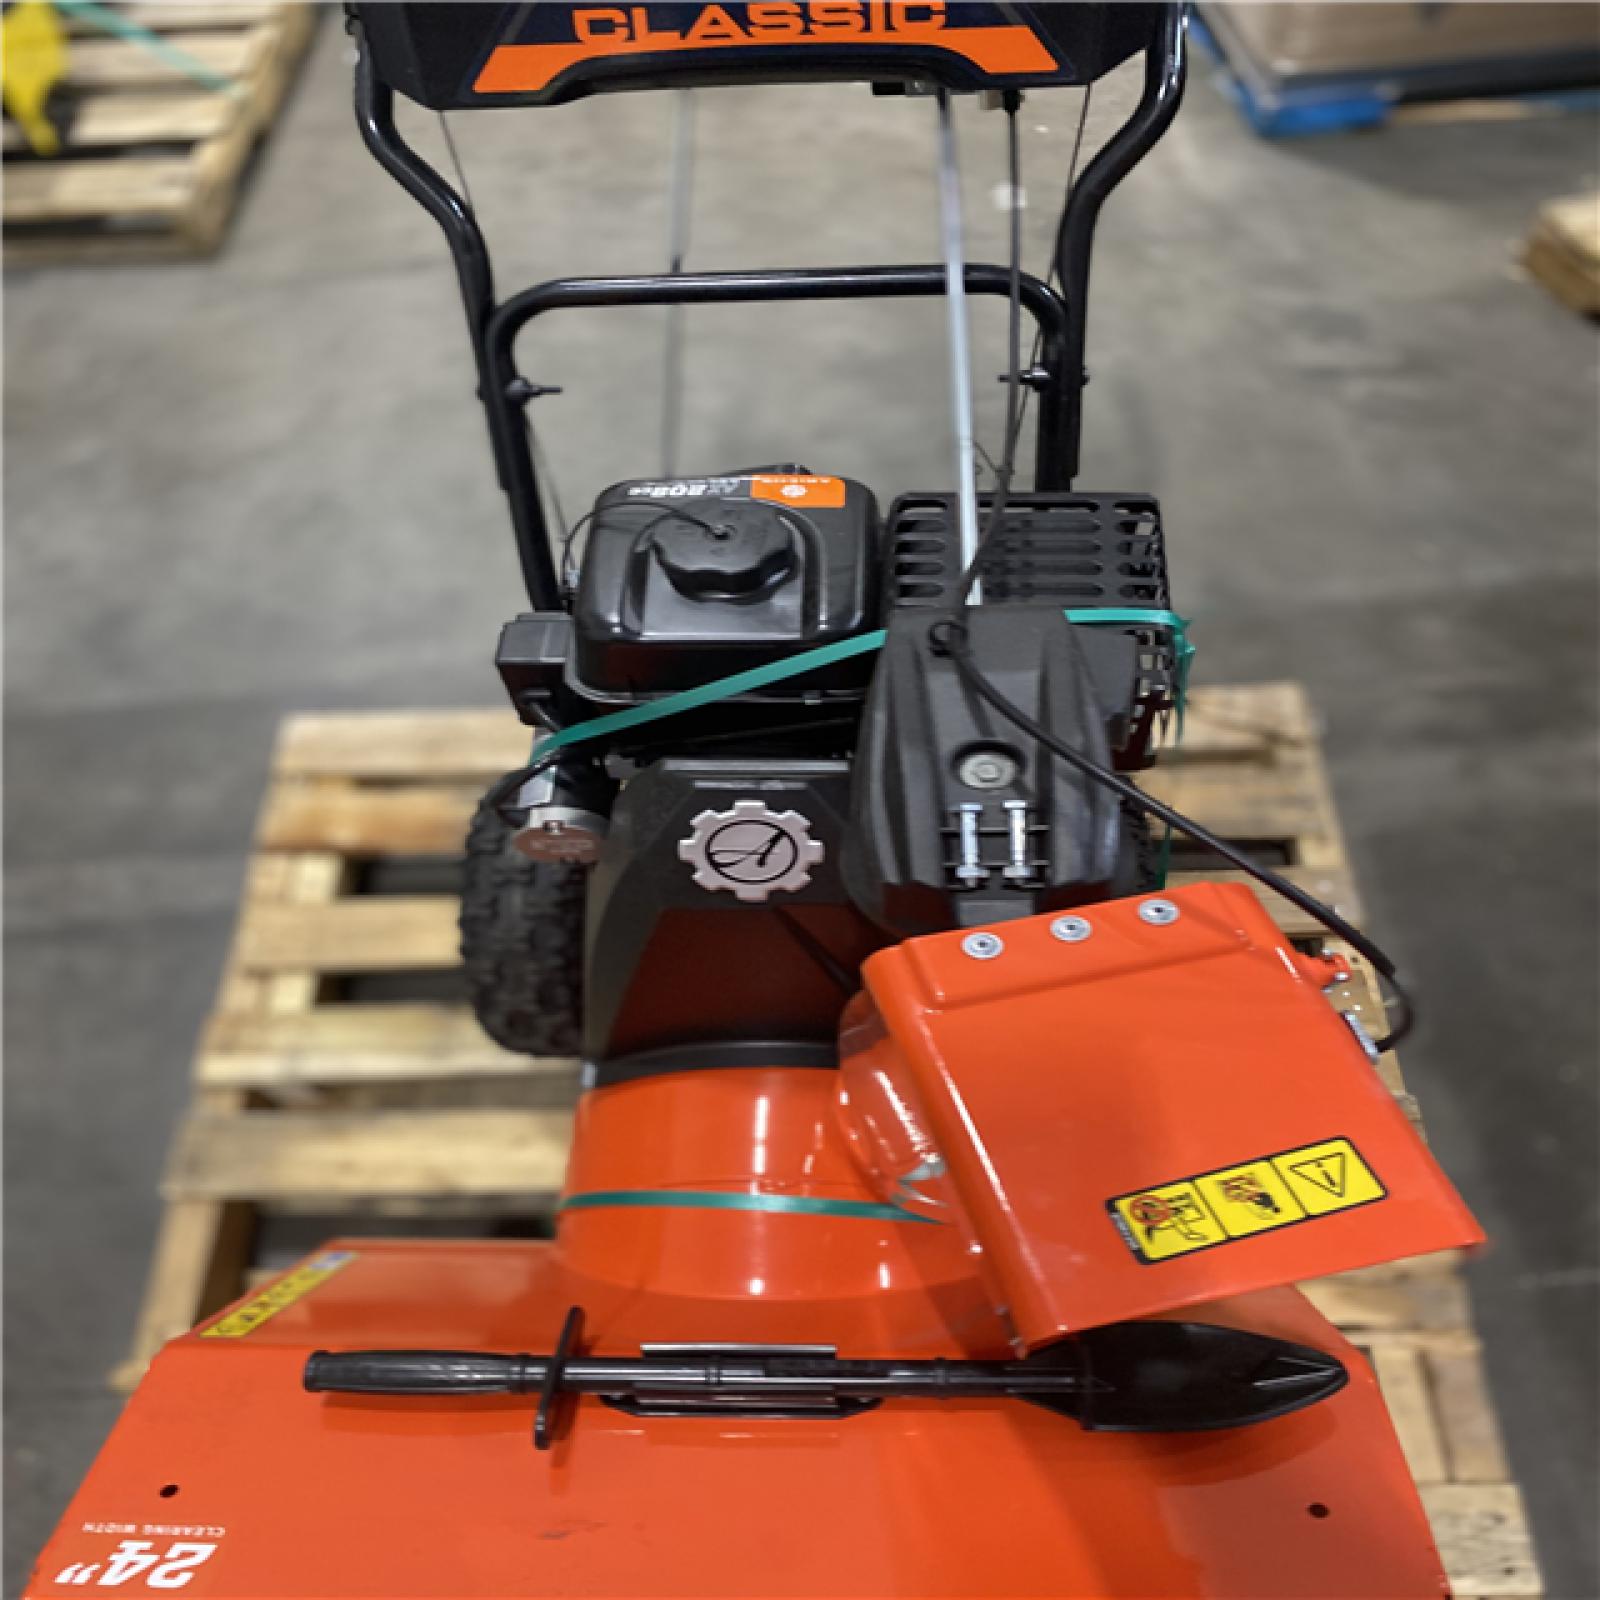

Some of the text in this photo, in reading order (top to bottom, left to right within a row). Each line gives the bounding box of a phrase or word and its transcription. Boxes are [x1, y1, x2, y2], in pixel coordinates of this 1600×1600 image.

[571, 1, 947, 43] CLASSIC
[82, 1521, 226, 1537] CLEARING WIDTH
